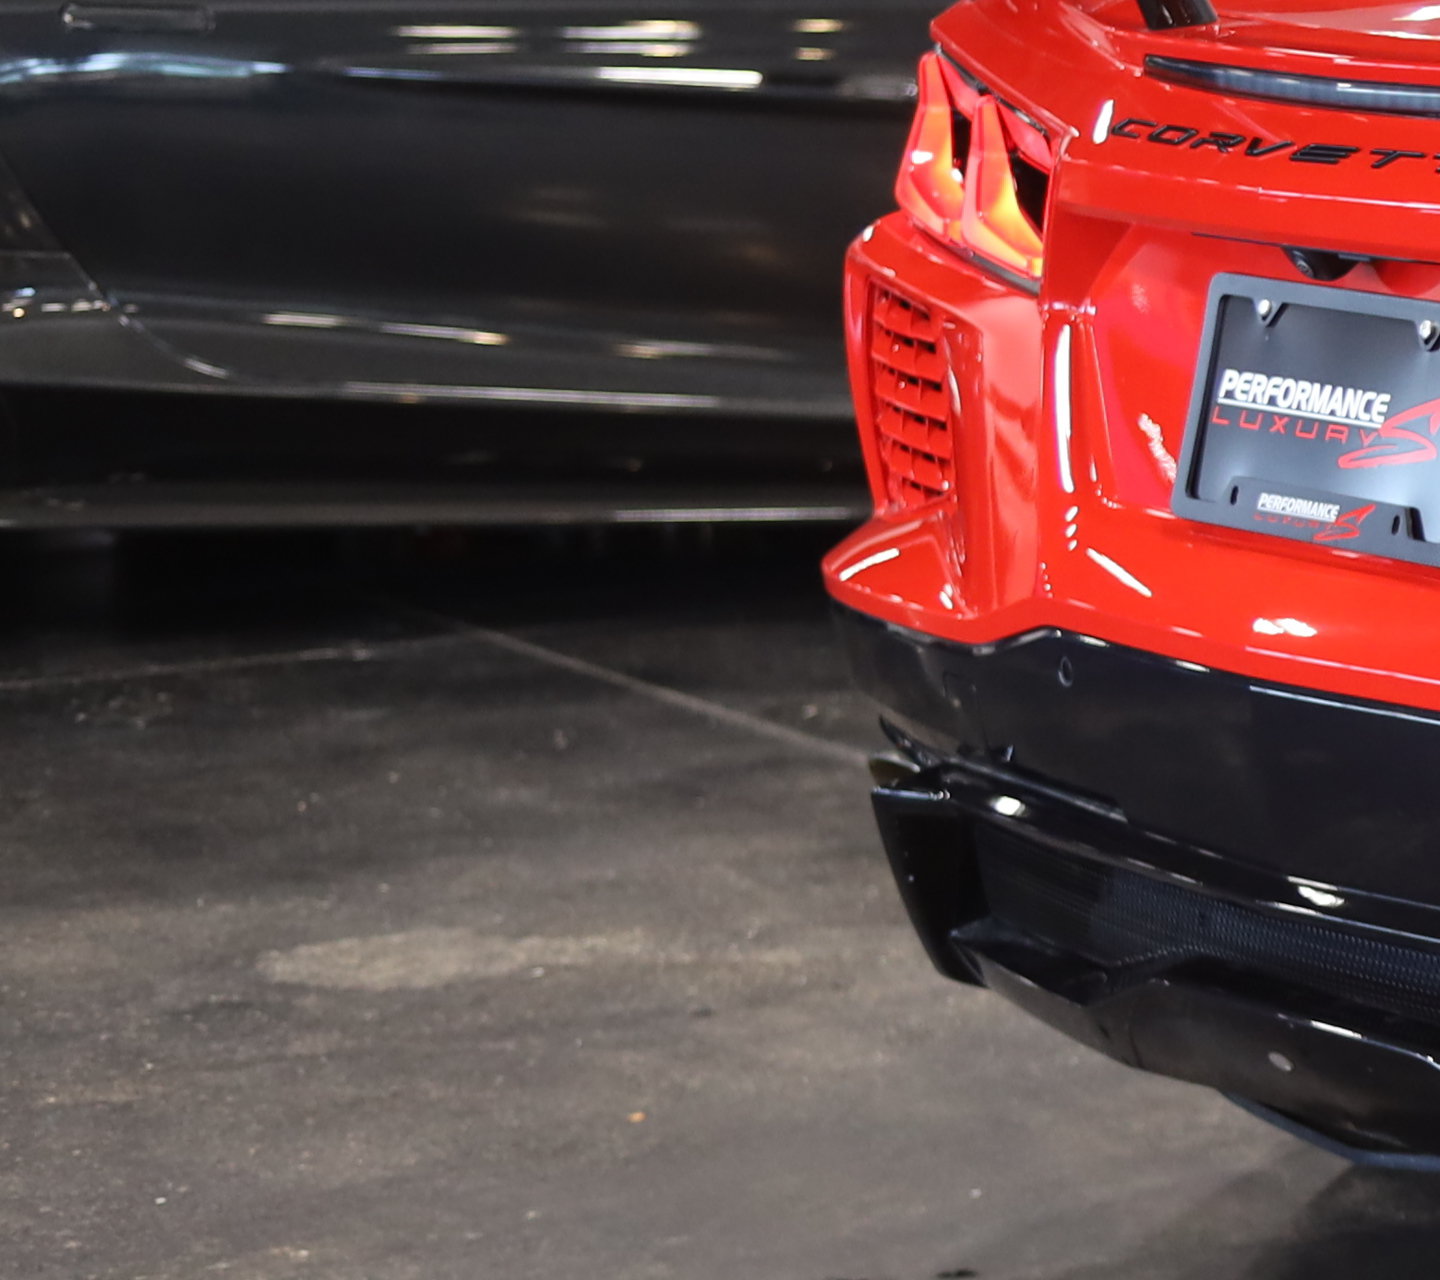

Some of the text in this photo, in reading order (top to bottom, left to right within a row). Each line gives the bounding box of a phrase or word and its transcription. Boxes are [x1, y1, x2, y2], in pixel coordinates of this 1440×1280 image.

[1218, 369, 1392, 423] PERFORMANCE
[1211, 407, 1380, 448] LUXURY
[1256, 493, 1341, 521] PERFORMANCE
